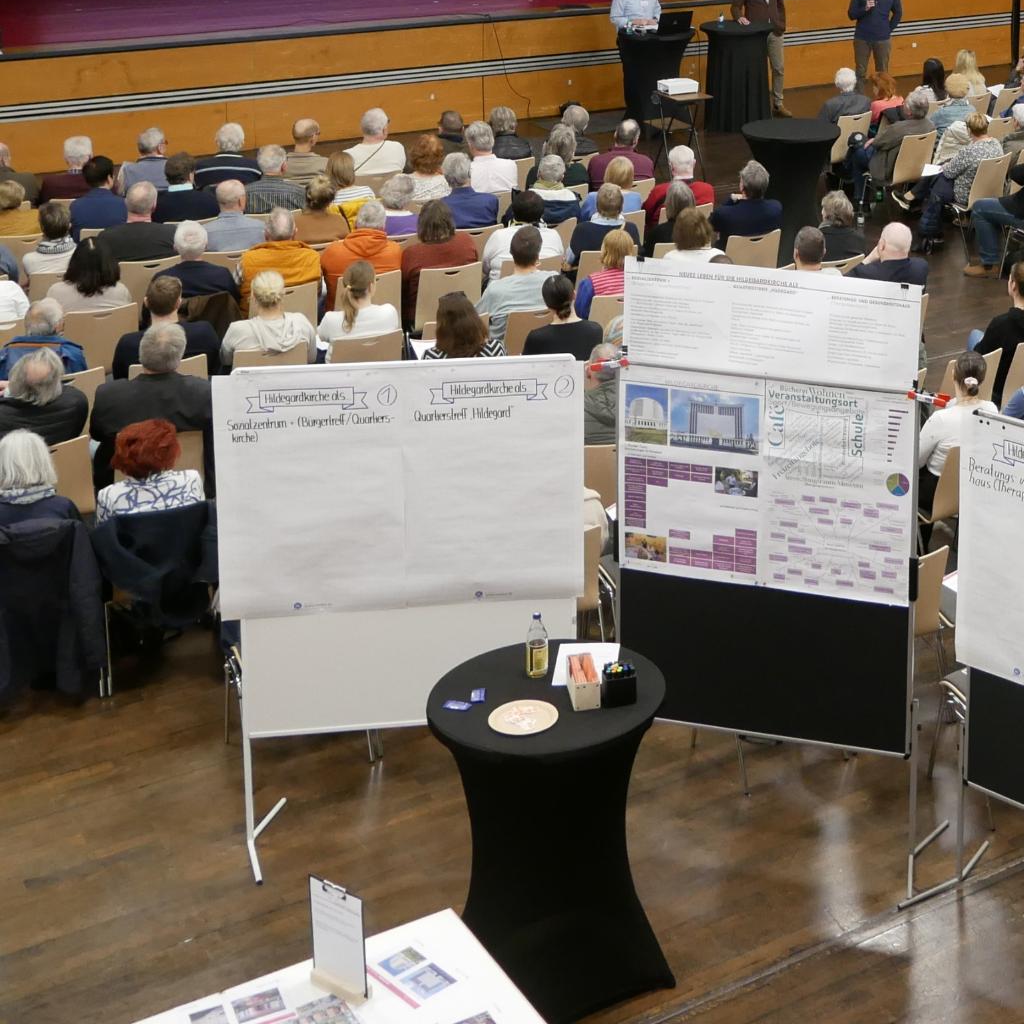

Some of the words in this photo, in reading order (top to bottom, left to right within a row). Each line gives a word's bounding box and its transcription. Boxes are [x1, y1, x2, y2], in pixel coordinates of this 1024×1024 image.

[450, 382, 513, 397] Hildegardkirche
[514, 381, 527, 393] als
[808, 387, 846, 399] Wohnen
[264, 391, 330, 405] Hildegardkirche
[331, 391, 346, 402] als
[768, 389, 858, 408] Veranstaltungsort
[413, 407, 468, 422] Quartierstreff
[226, 418, 288, 431] Sozialzentrum
[231, 431, 259, 443] kirche)
[852, 414, 864, 456] Schule
[968, 472, 991, 488] haus
